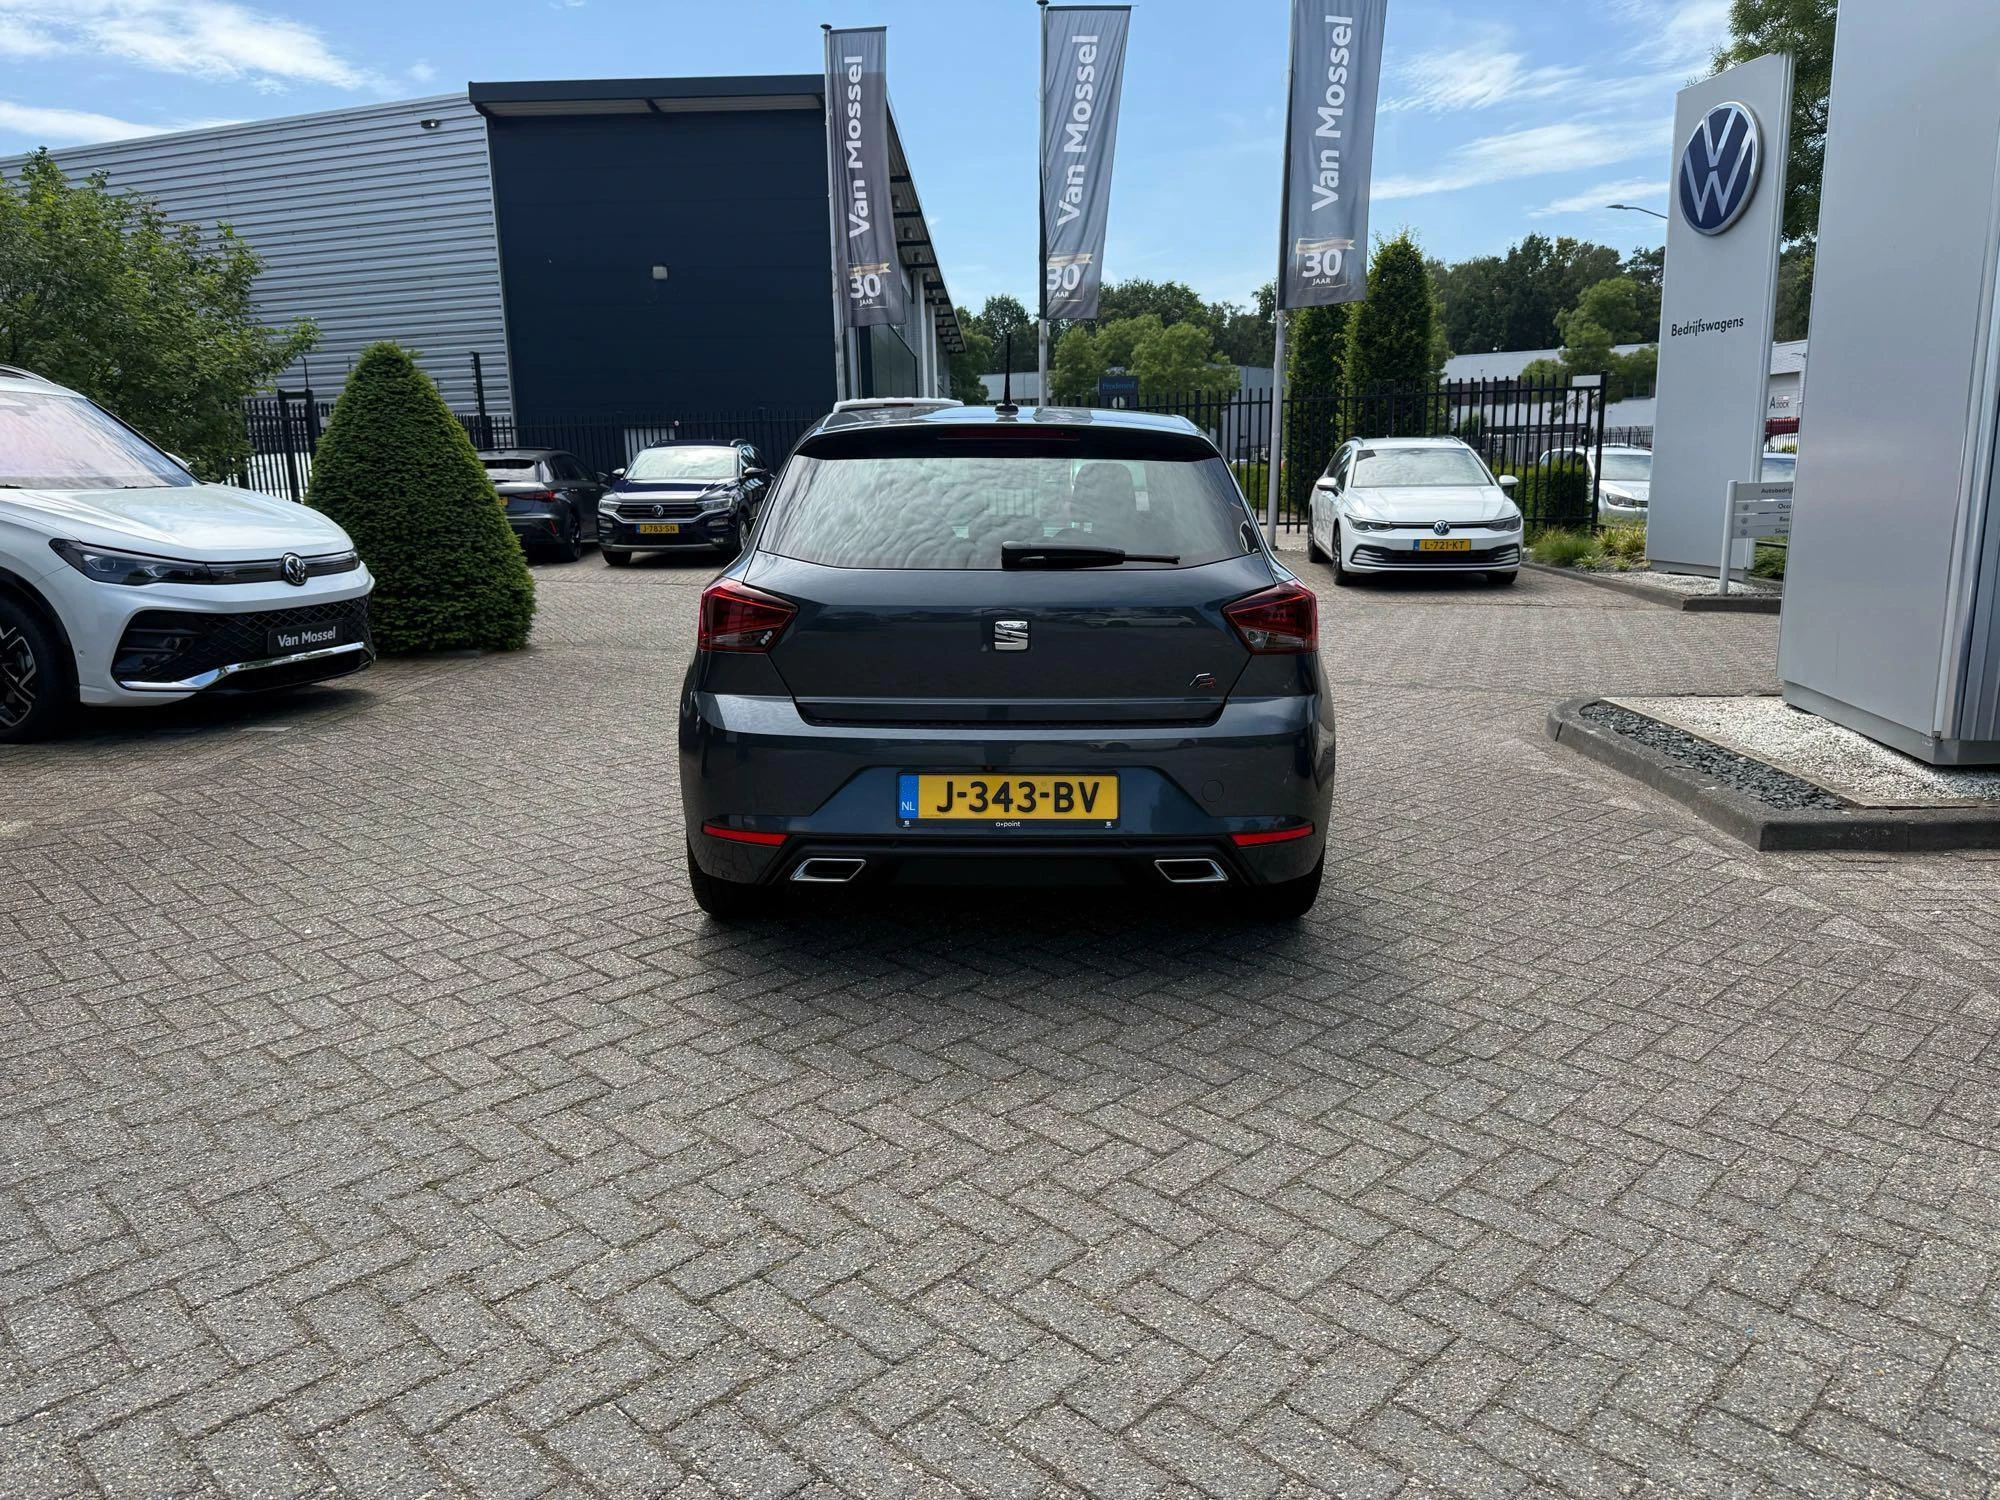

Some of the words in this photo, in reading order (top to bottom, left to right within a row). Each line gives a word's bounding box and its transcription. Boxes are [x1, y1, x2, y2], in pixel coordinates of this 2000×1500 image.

[1316, 15, 1353, 138] Mossel
[1064, 35, 1098, 153] Mossel
[844, 55, 863, 169] Mossel
[1057, 165, 1085, 226] Van
[1311, 150, 1340, 212] Van
[849, 180, 871, 239] Van
[1047, 263, 1081, 291] 30
[1302, 249, 1343, 278] 30
[850, 274, 881, 299] 30
[1312, 277, 1331, 286] JAAR
[1671, 318, 1744, 336] Bedrijfswagens
[277, 634, 299, 648] Van
[301, 626, 337, 644] Mossel
[901, 801, 916, 811] NL
[936, 781, 1100, 813] J-343-BV
